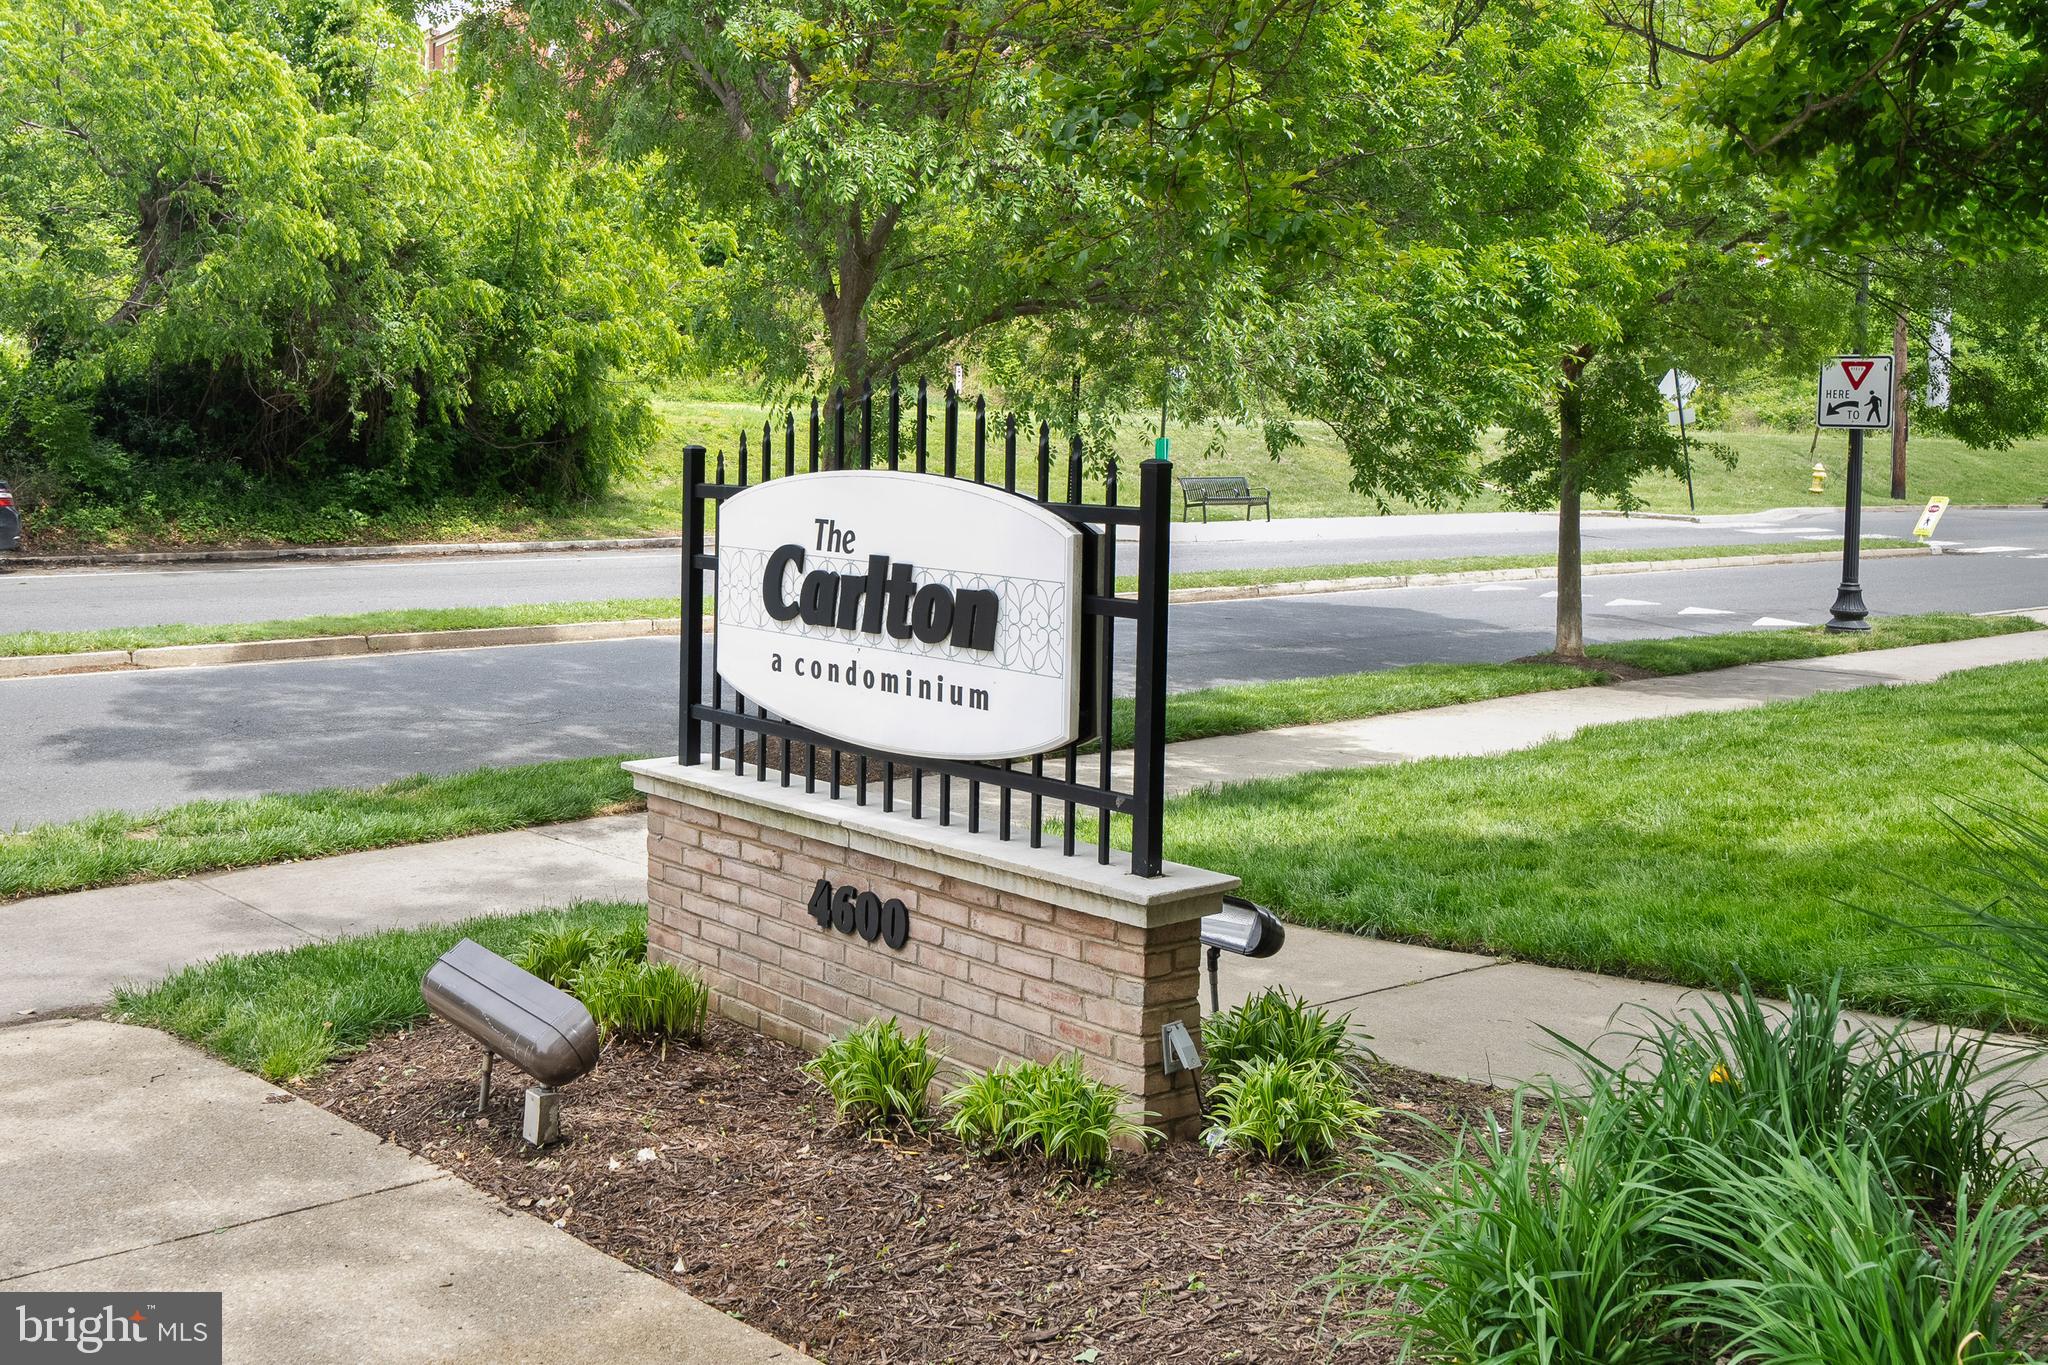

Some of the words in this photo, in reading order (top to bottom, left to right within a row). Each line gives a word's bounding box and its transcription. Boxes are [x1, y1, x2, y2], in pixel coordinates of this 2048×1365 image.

[1825, 389, 1850, 399] HERE
[1847, 410, 1860, 420] TO
[814, 518, 857, 554] The
[763, 544, 999, 651] Carlton
[772, 653, 782, 673] a
[794, 657, 989, 711] condominium
[807, 879, 909, 949] 4600
